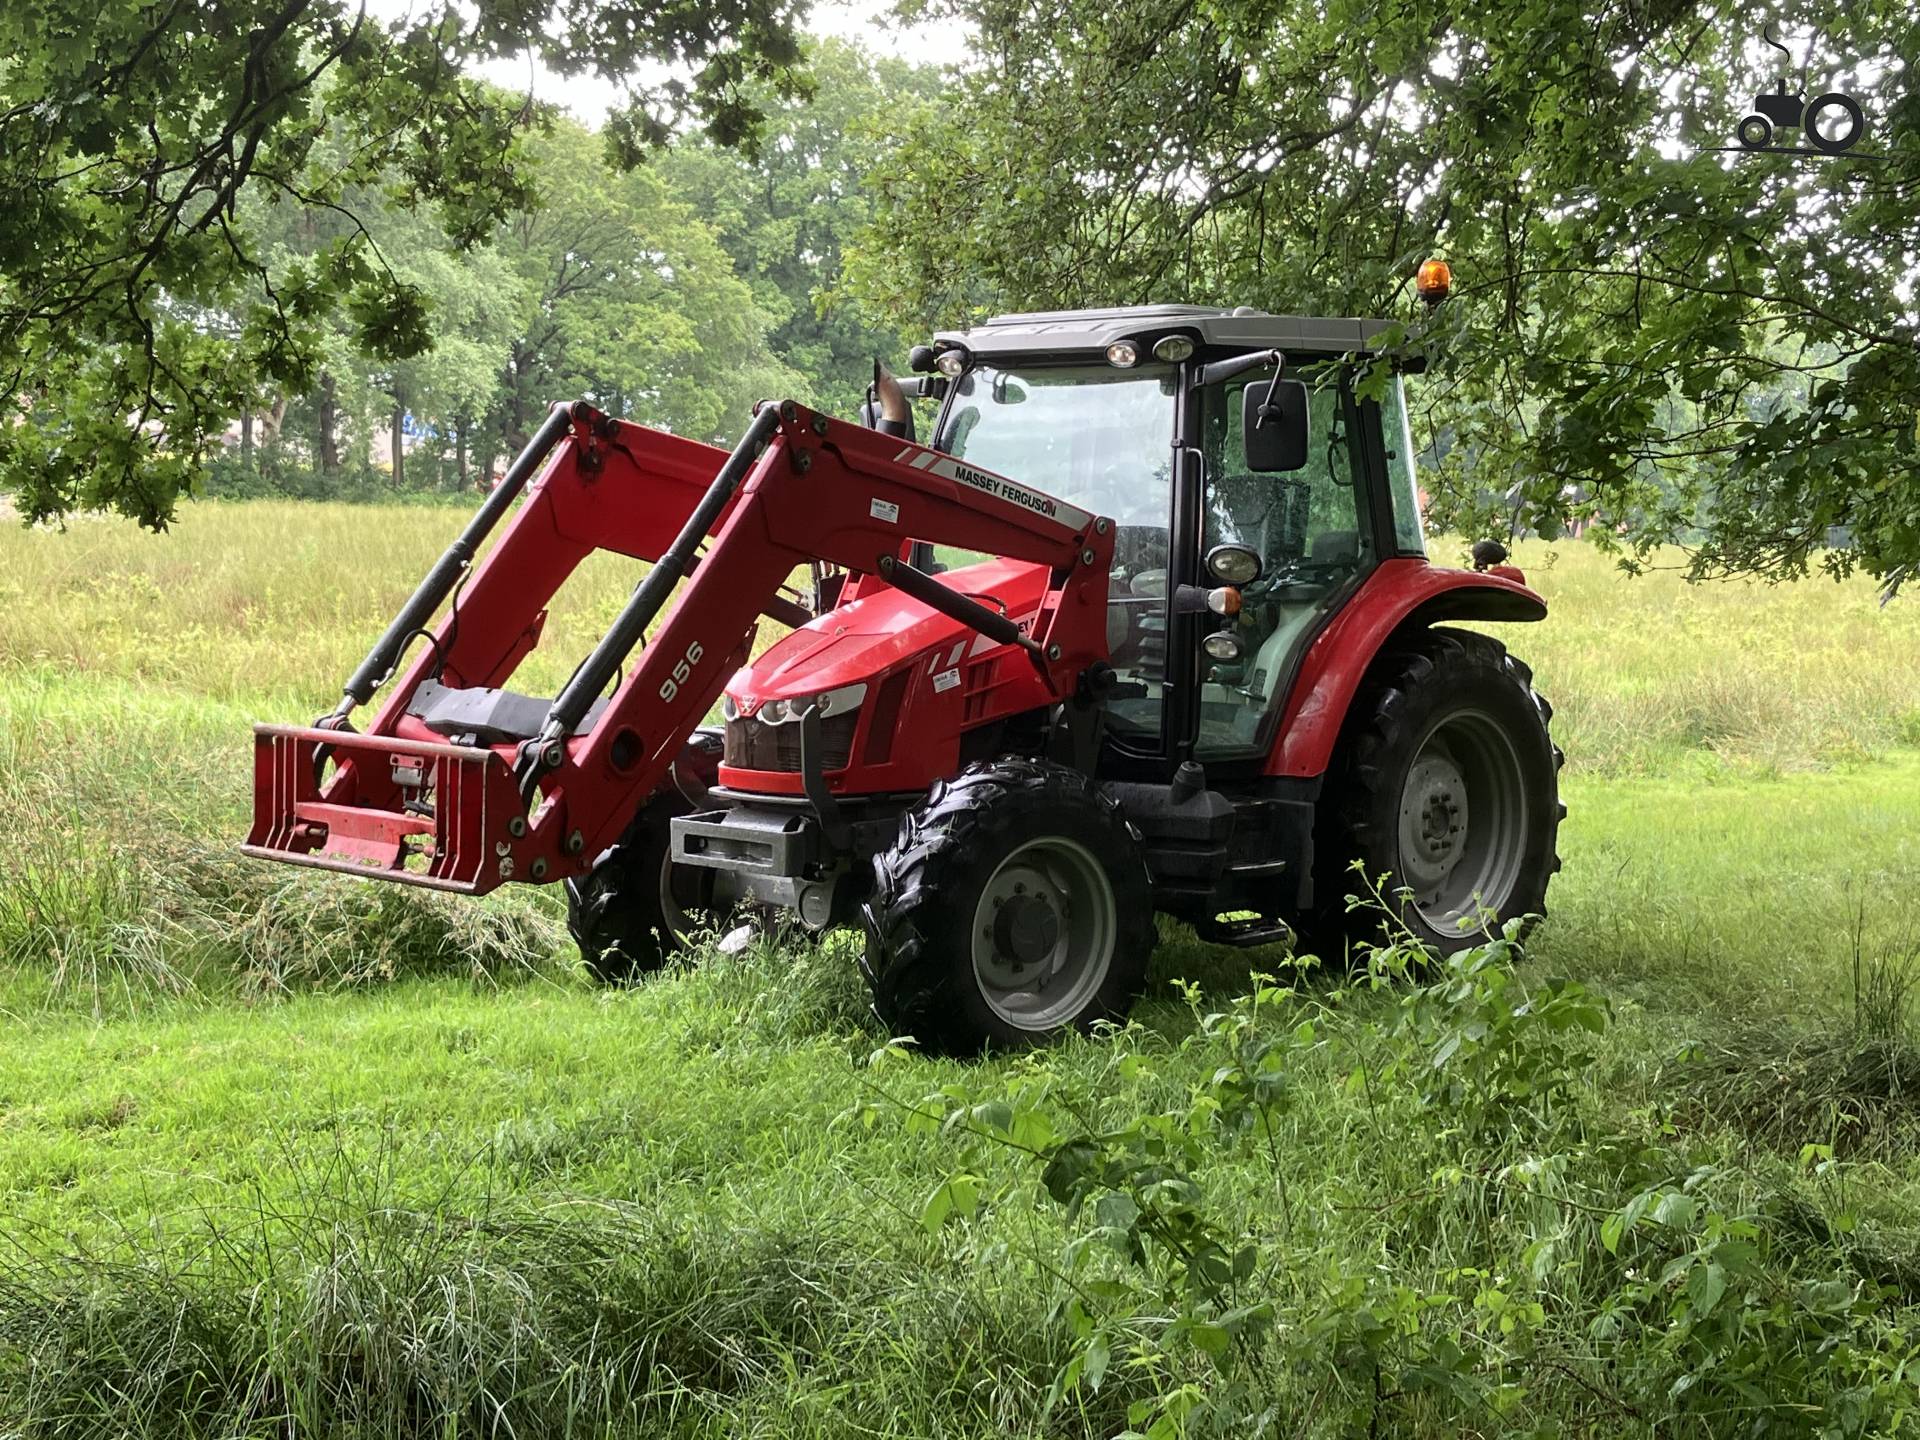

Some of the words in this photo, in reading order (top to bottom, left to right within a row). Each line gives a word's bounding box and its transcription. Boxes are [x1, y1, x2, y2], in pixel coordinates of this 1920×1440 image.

[955, 466, 1000, 493] MASSEY
[1001, 484, 1057, 517] FERGUSON
[659, 640, 704, 703] 956
